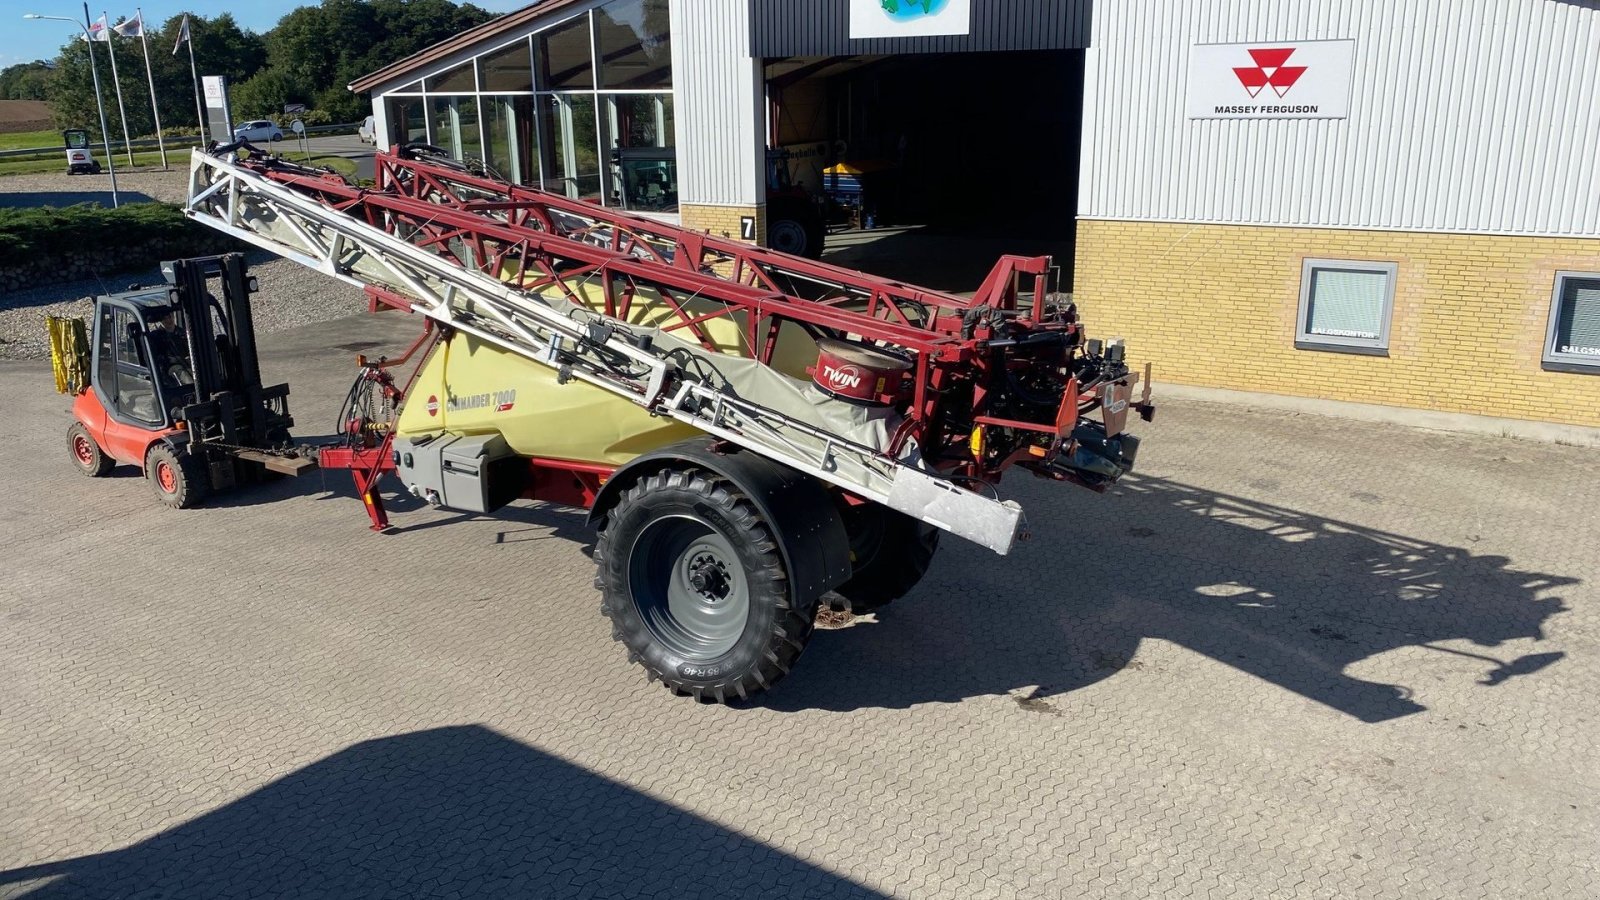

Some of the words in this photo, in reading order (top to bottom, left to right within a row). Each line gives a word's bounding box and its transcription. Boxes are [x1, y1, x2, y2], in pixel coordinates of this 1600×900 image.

[1214, 105, 1258, 114] MASSEY
[1260, 105, 1319, 113] FERGUSON
[742, 218, 753, 238] 7
[1311, 327, 1375, 339] SALGSKONTOR
[823, 365, 861, 388] TWIN
[492, 388, 516, 406] 7000
